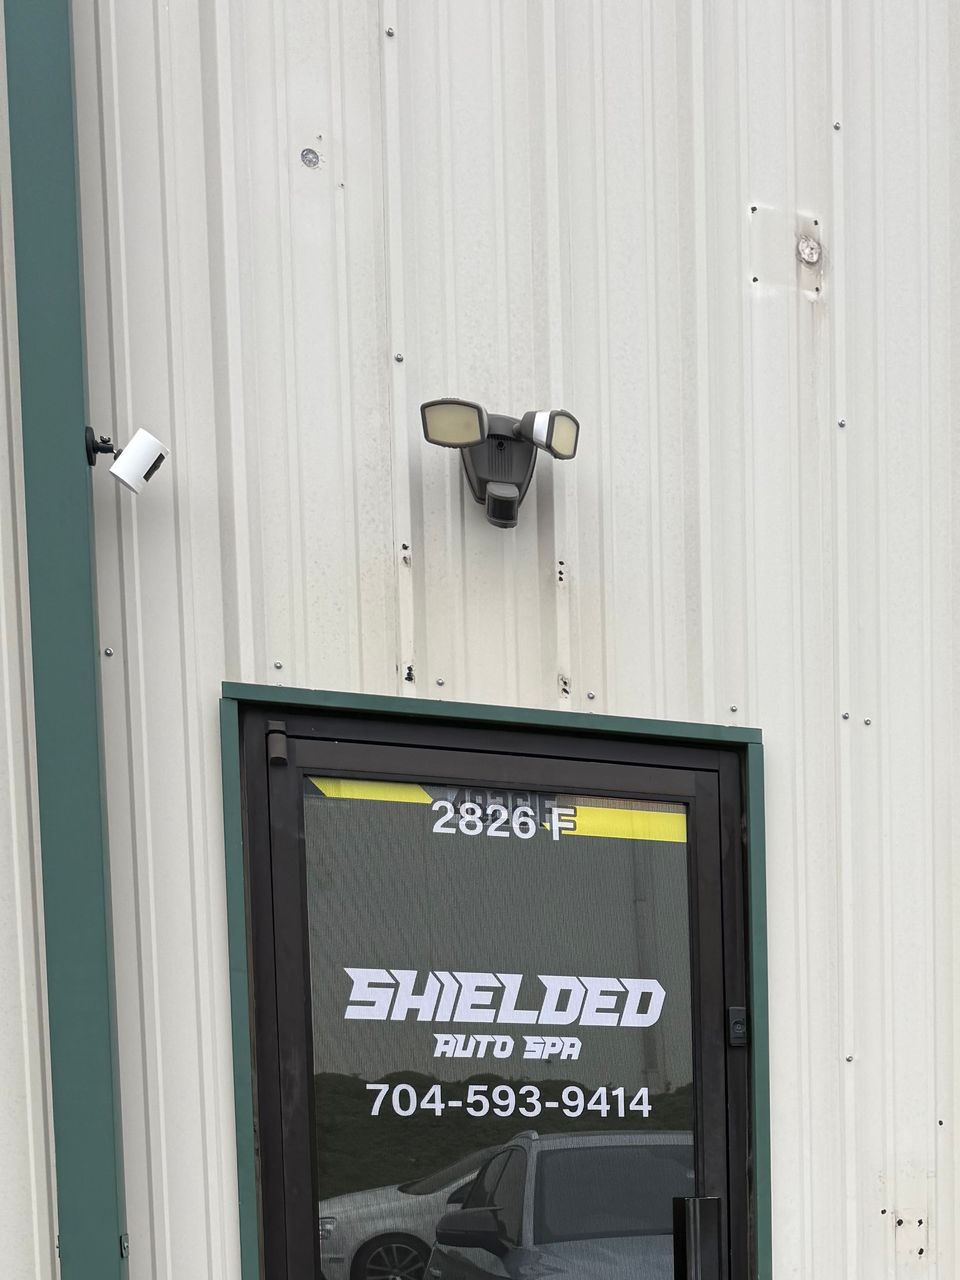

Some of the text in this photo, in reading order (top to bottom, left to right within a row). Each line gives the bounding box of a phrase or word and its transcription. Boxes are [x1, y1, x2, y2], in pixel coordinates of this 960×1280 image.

[430, 799, 537, 840] 2826
[551, 807, 575, 841] F
[343, 967, 667, 1028] SHIELDED
[433, 1033, 582, 1060] AUTO SPA
[366, 1083, 652, 1118] 704-593-9414
